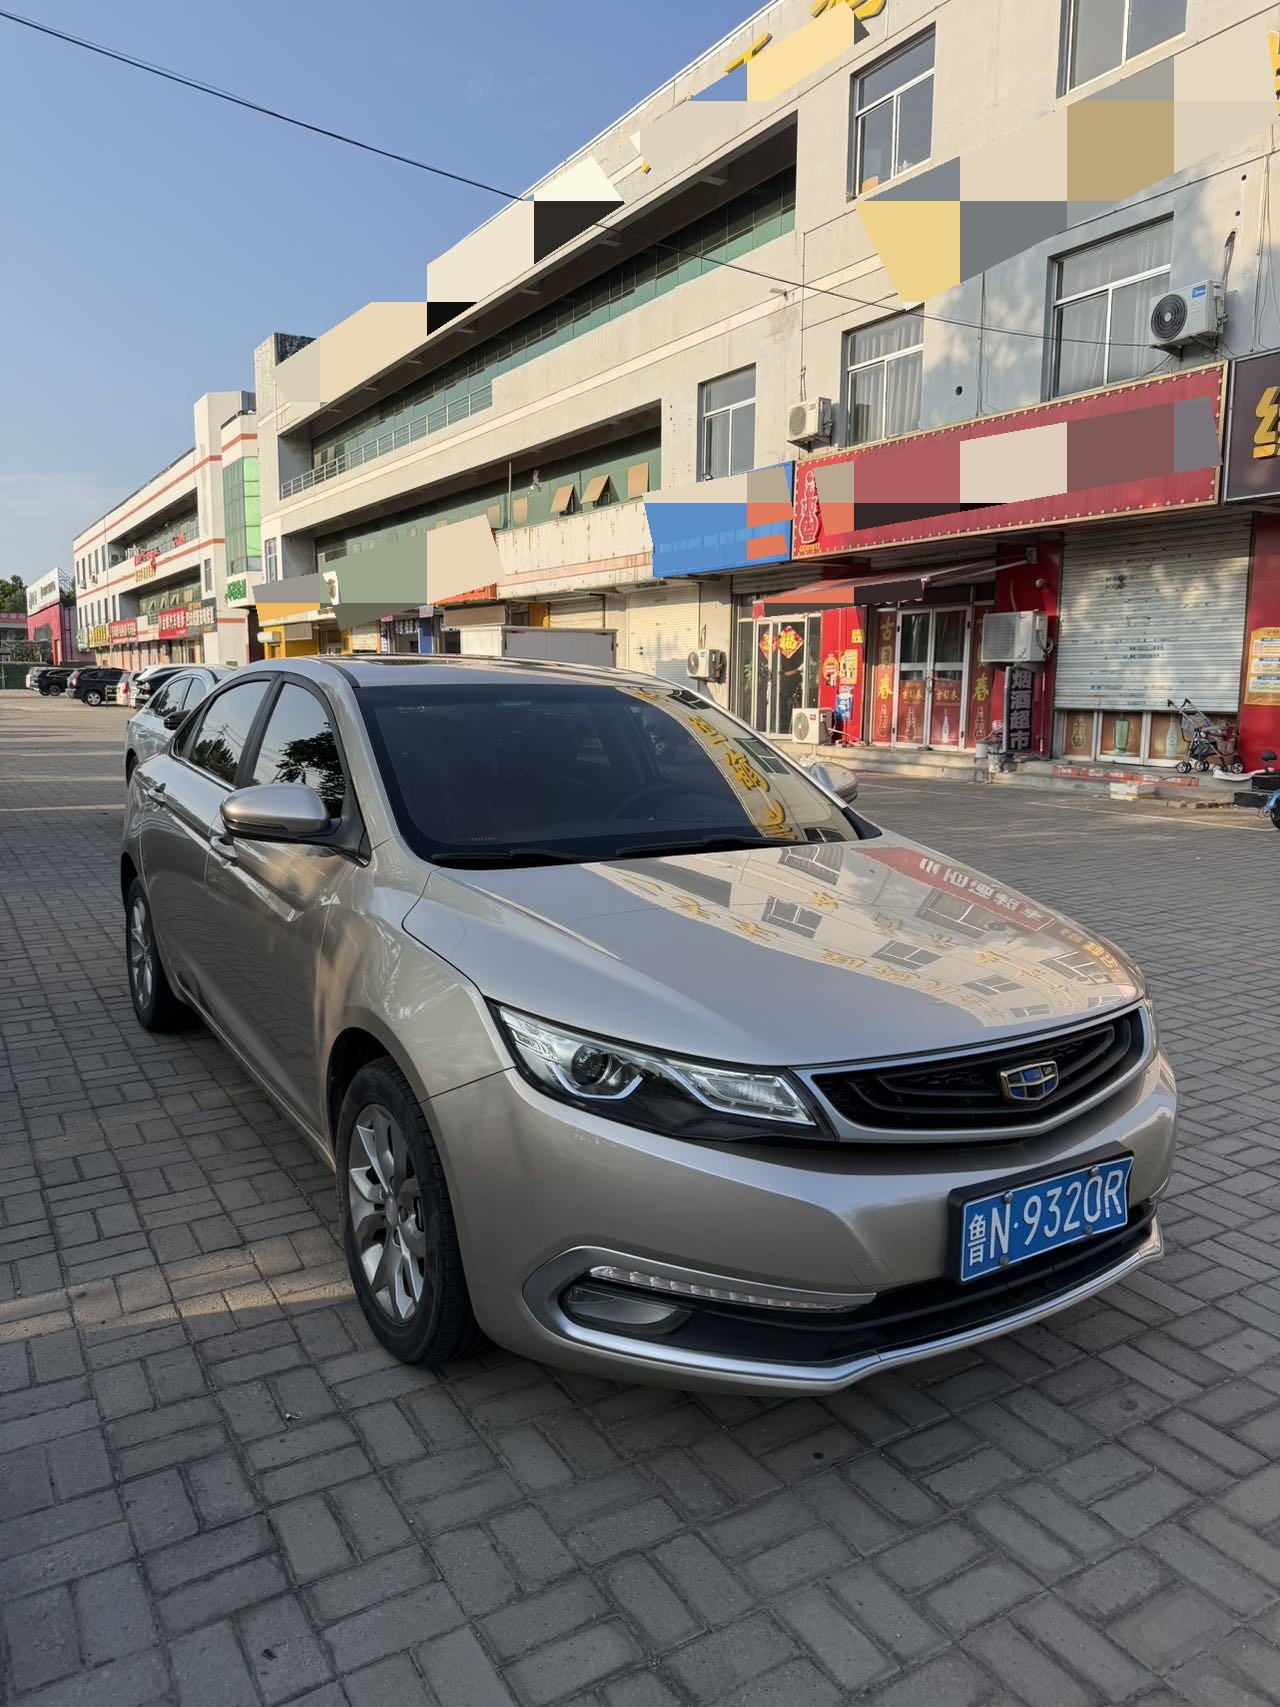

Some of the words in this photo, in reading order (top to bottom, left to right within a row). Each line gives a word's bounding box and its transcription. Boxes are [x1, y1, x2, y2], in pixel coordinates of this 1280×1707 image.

[1010, 669, 1033, 750] 烟酒超市
[967, 1169, 1123, 1266] 鲁N·9320R
